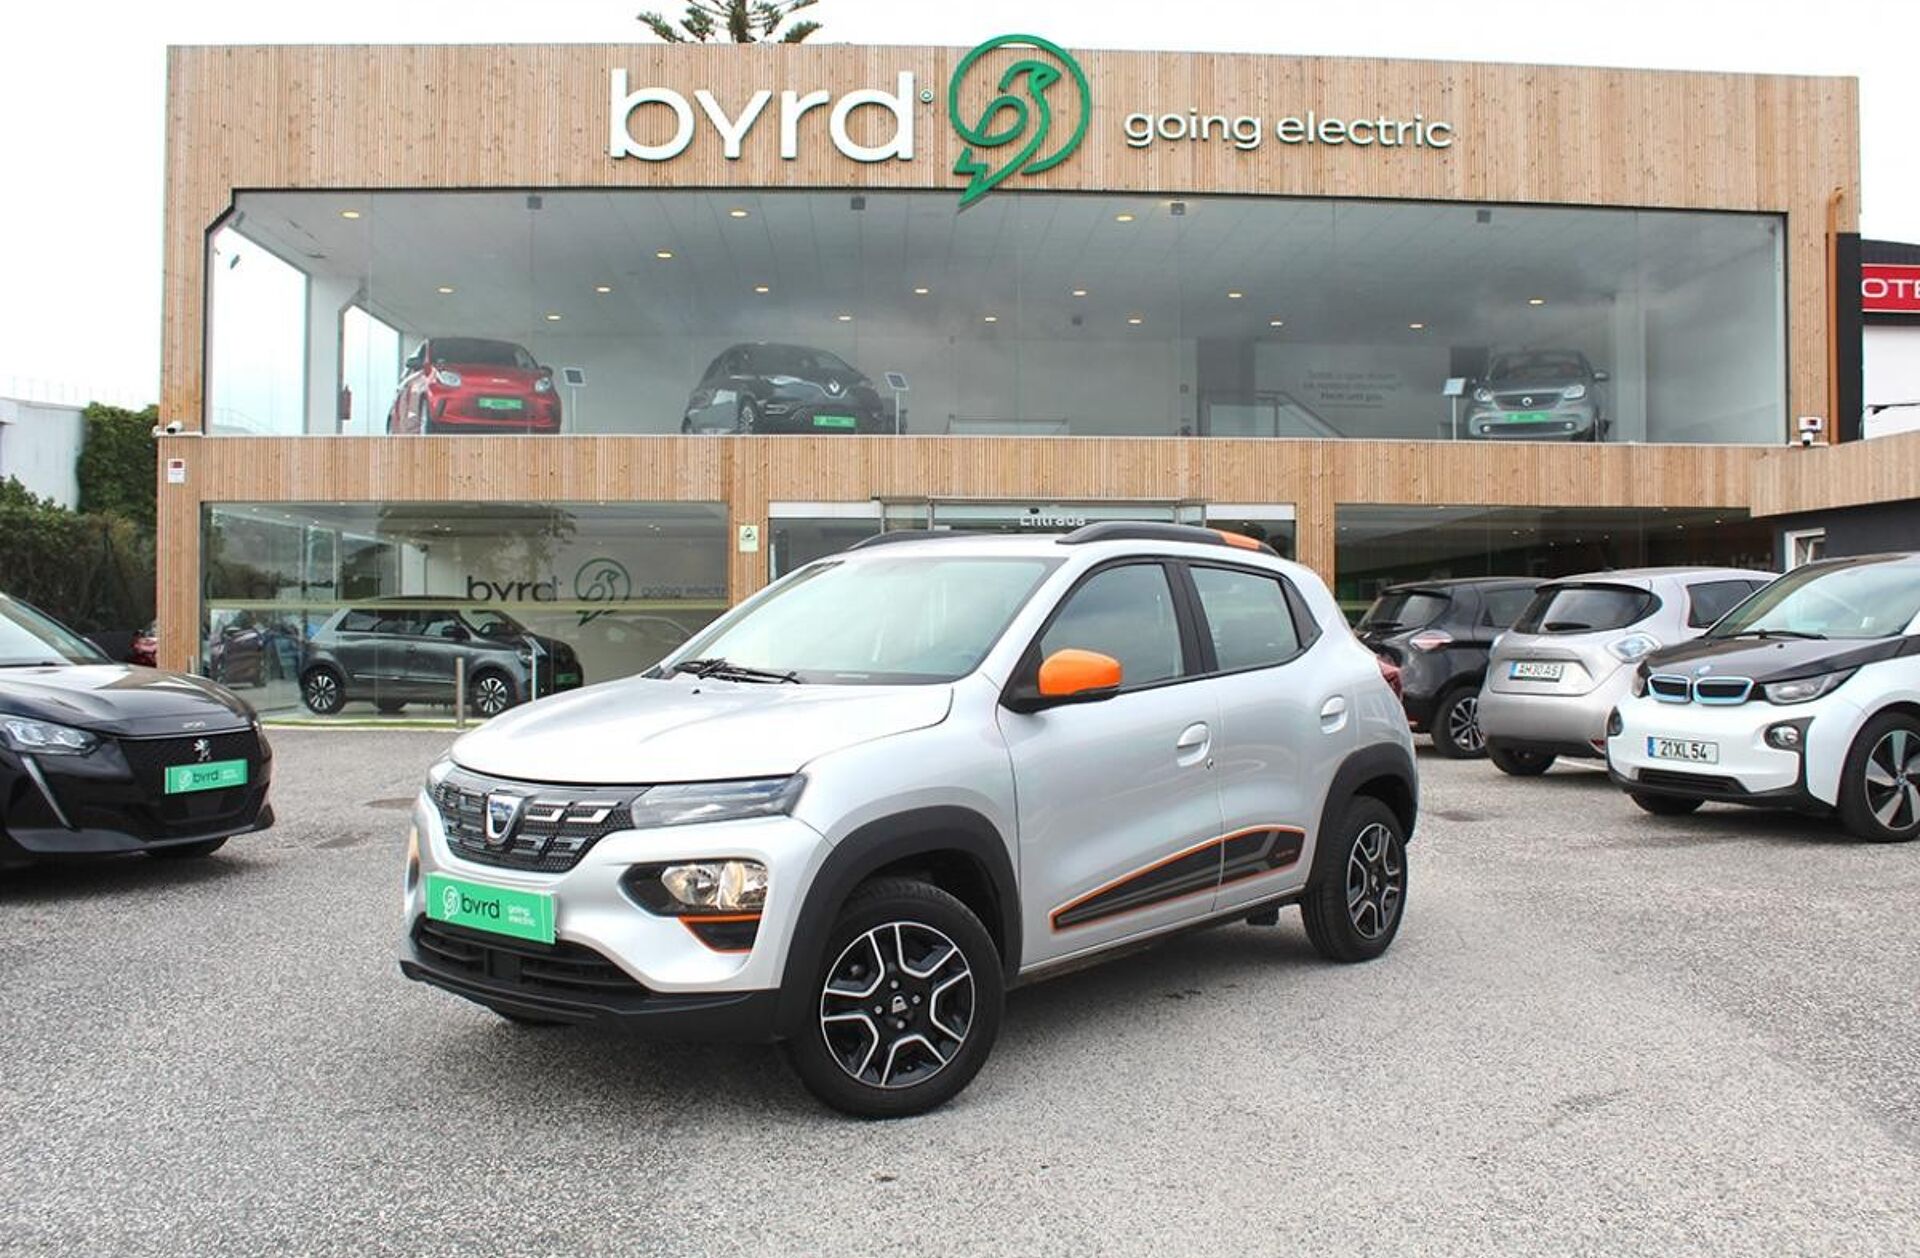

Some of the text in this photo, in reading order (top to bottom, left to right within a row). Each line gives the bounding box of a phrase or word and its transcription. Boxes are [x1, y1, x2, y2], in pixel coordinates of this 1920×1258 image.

[1123, 107, 1454, 151] going electric
[466, 575, 558, 602] byrd
[461, 893, 500, 918] byrd
